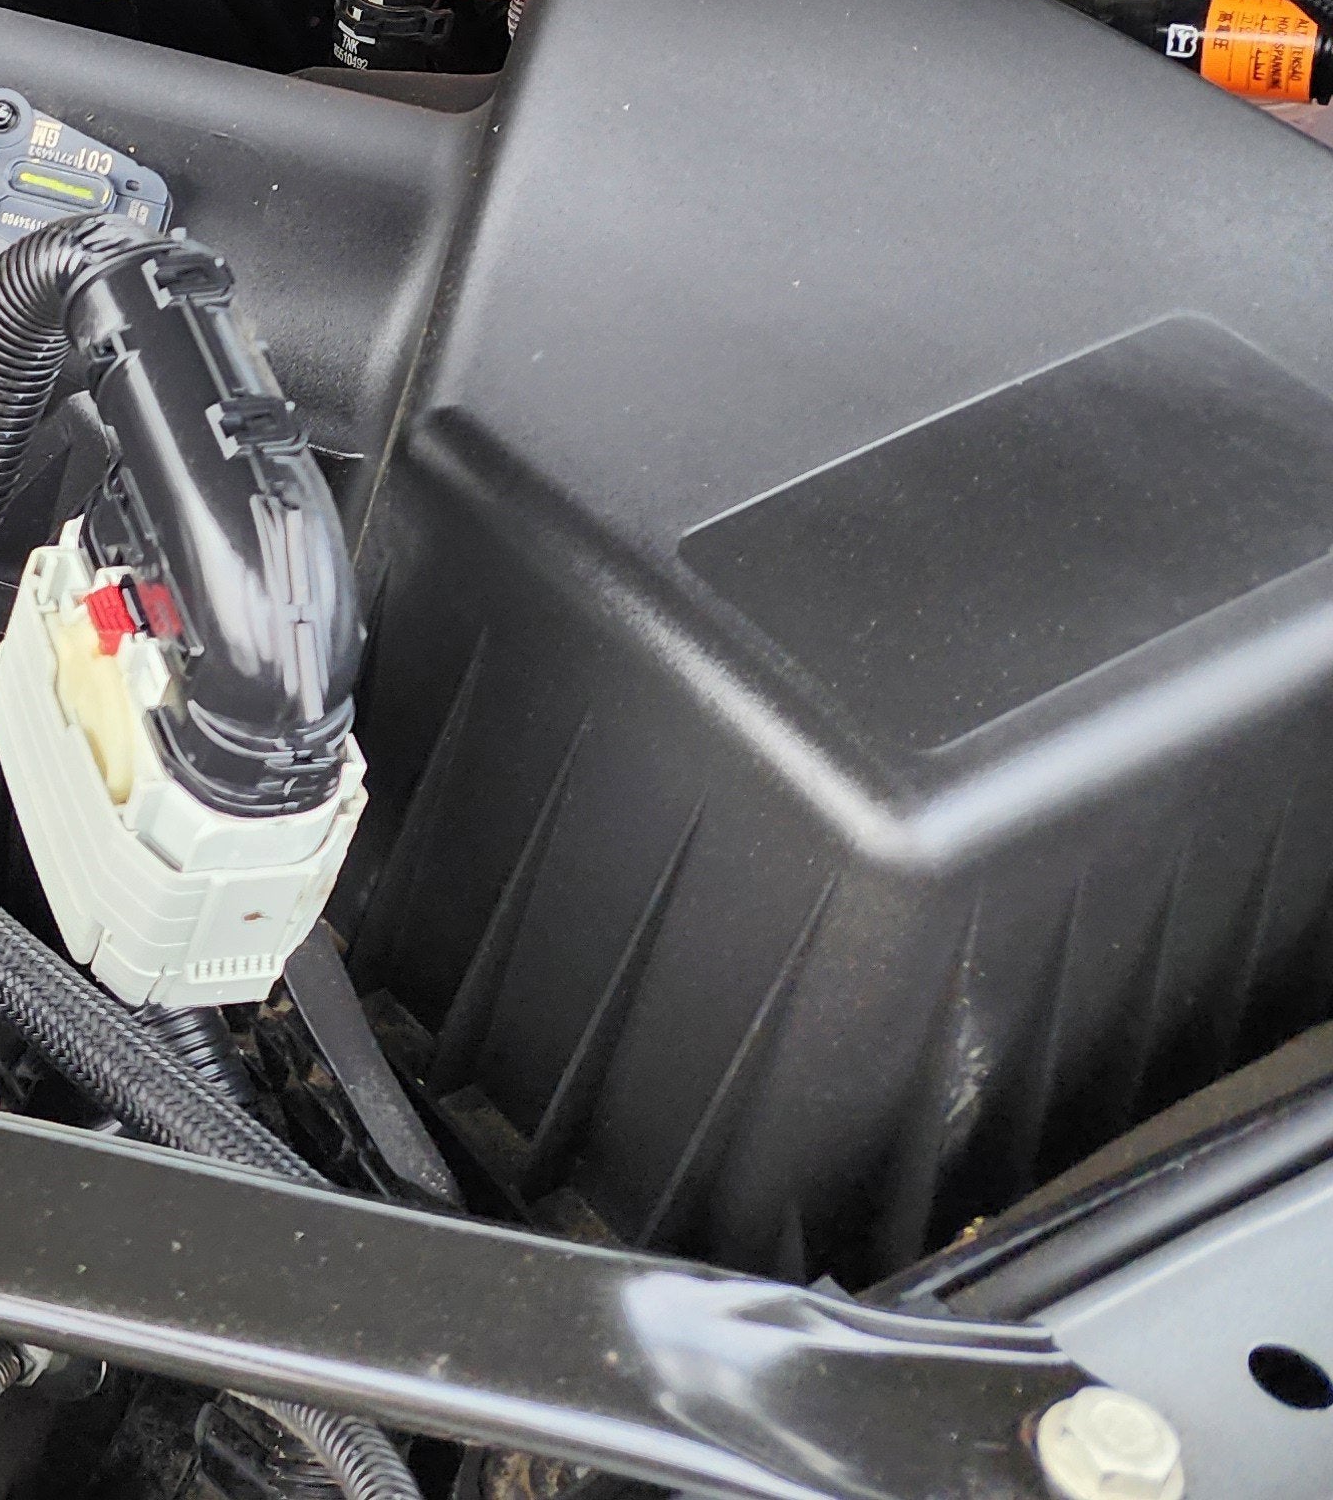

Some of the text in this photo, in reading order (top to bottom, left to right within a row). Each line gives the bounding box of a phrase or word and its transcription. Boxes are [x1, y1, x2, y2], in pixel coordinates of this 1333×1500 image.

[341, 33, 360, 55] TNK
[30, 125, 61, 149] GM
[76, 147, 114, 176] C01
